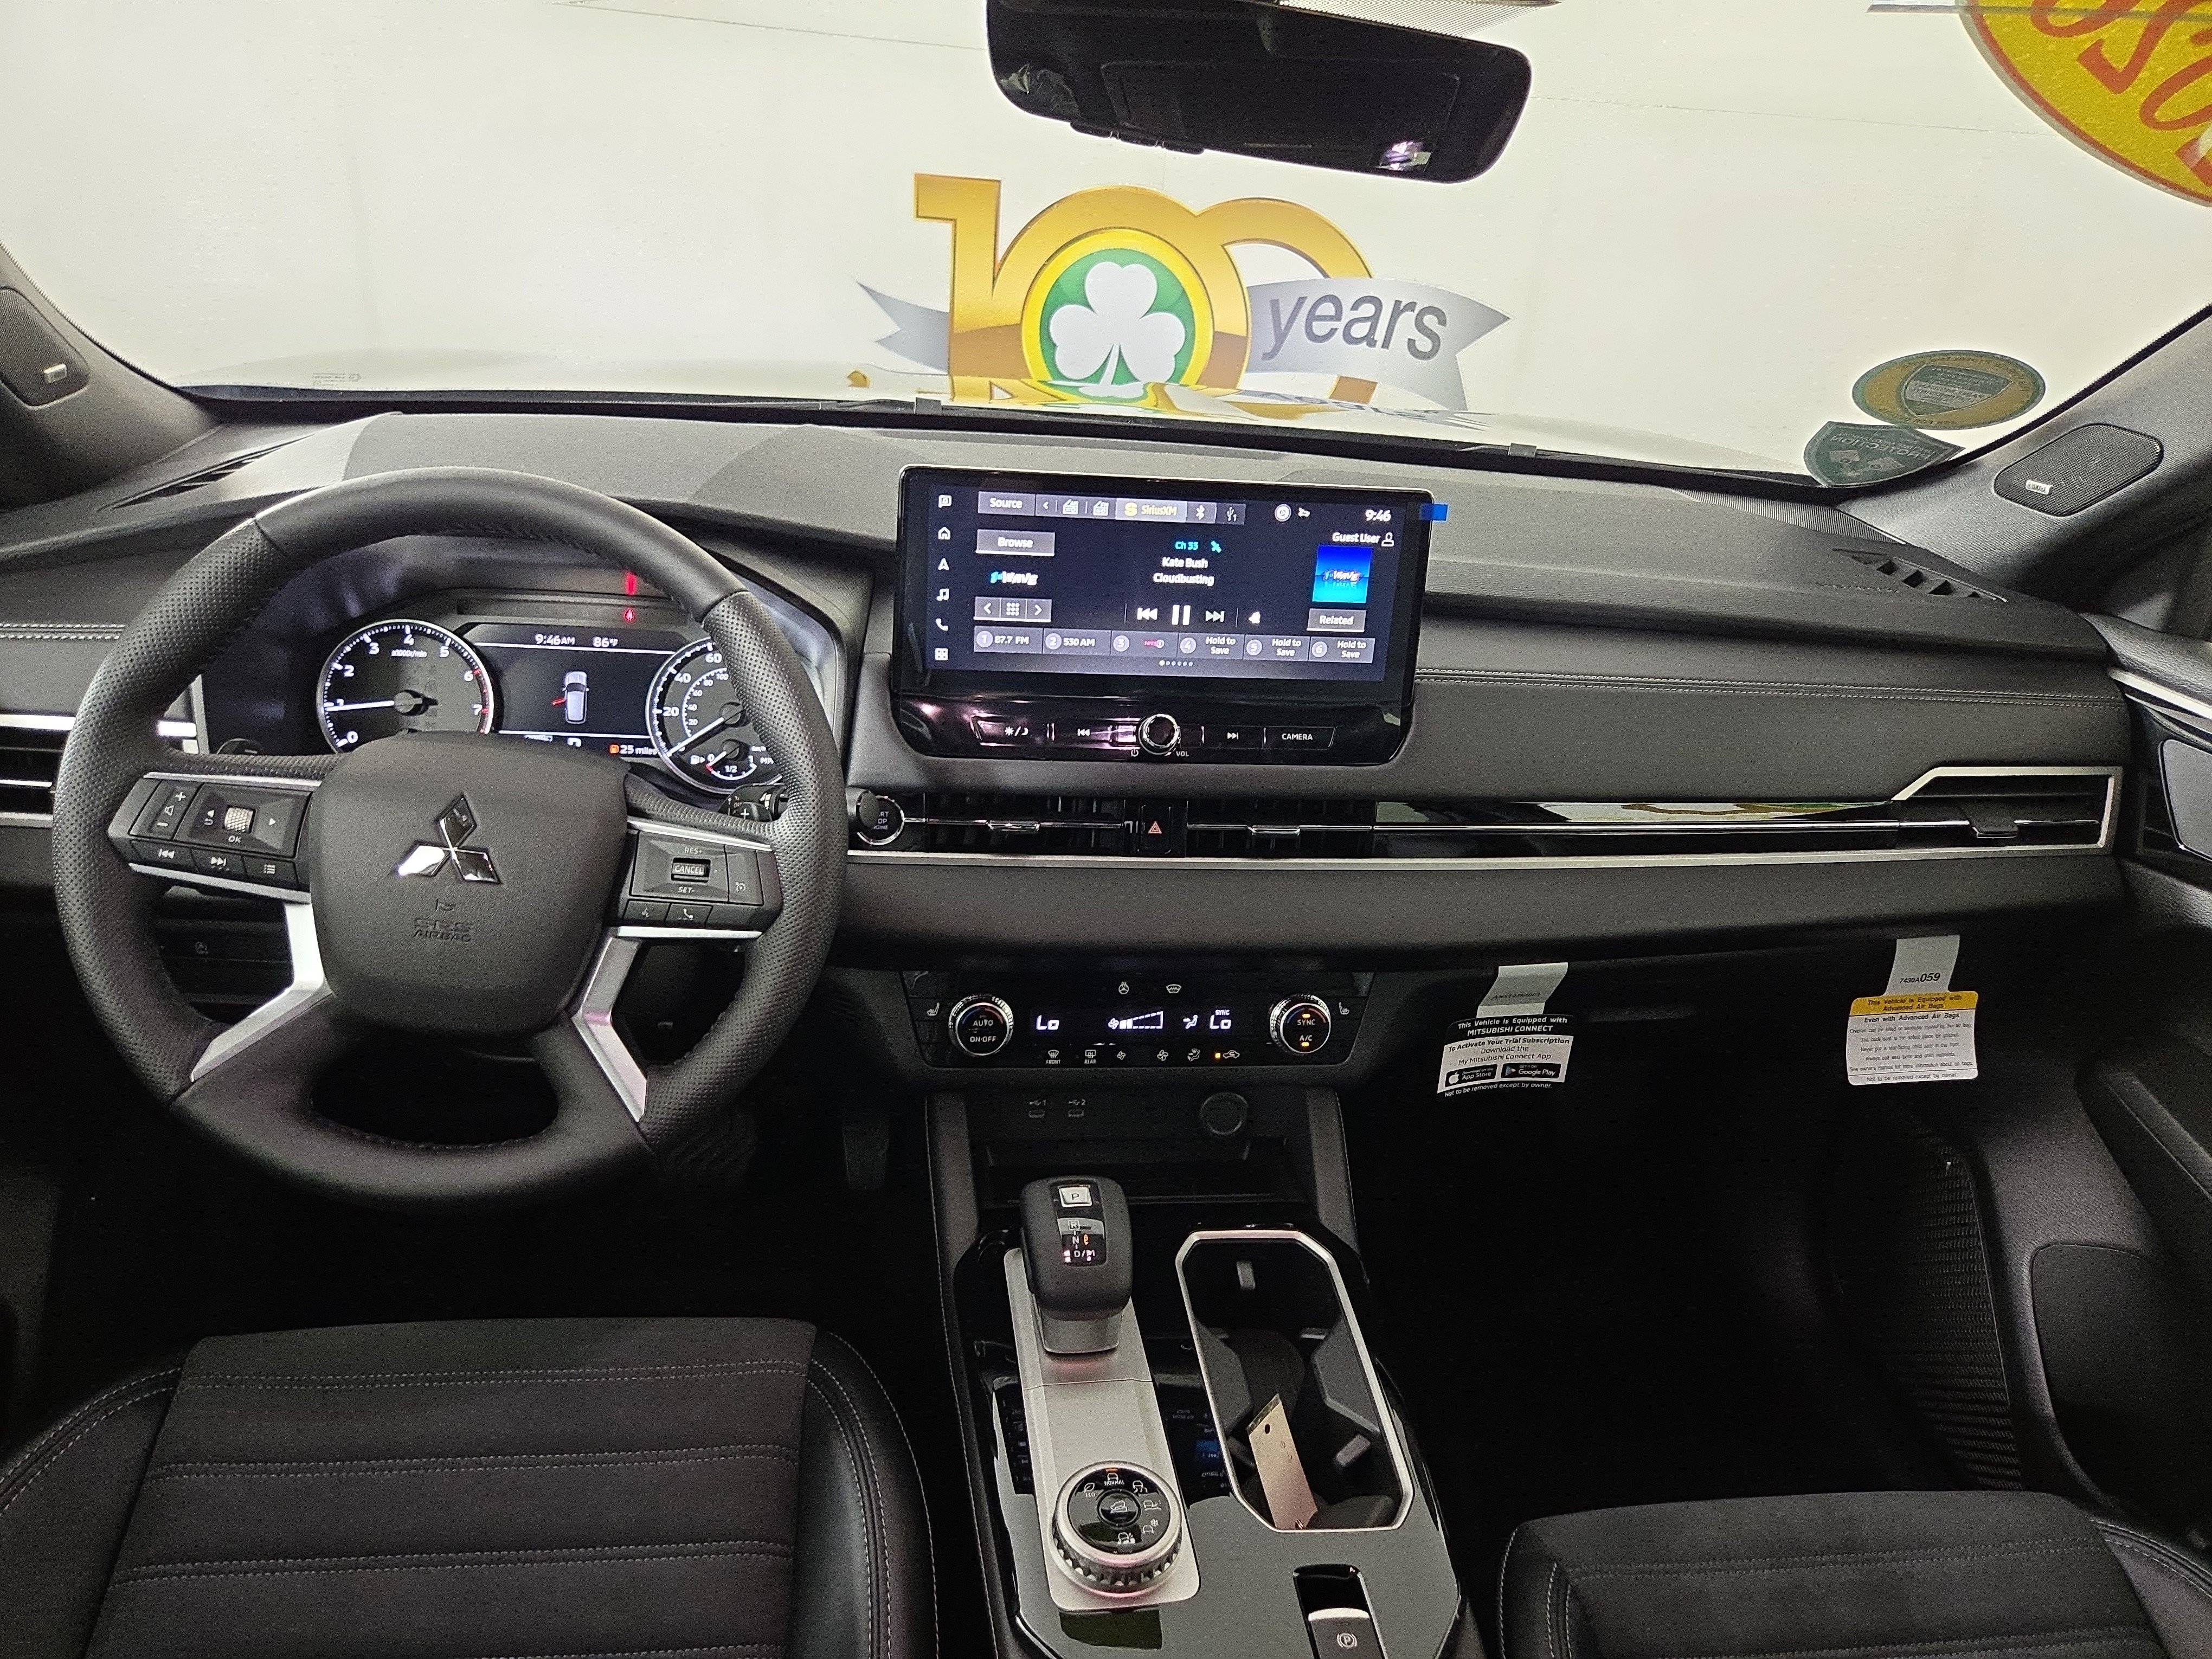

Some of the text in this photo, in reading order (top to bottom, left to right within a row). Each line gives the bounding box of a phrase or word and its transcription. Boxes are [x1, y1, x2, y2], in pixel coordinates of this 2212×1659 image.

[1261, 289, 1450, 362] years
[989, 497, 1024, 509] Source
[1141, 505, 1178, 516] SiriusXM
[1365, 509, 1392, 522] 9:46
[998, 537, 1034, 548] Browse
[1332, 532, 1380, 544] Guest User
[1174, 541, 1186, 550] Ch
[1162, 557, 1208, 569] Kate Bush
[1153, 573, 1214, 587] Cloudbusting
[1319, 615, 1354, 626] Related
[403, 634, 415, 646] 4
[981, 635, 1030, 645] 1 87.7 FM
[1050, 636, 1095, 647] 2 530 AM
[1117, 639, 1124, 647] 3
[1184, 641, 1192, 650] 4
[1206, 636, 1237, 646] Hold to
[1272, 638, 1302, 647] Hold to
[1337, 640, 1367, 650] Hold to
[369, 642, 380, 654] 3
[440, 646, 449, 658] 5
[1210, 646, 1230, 655] Save
[1250, 642, 1258, 652] 5
[1276, 648, 1296, 657] Save
[1315, 645, 1323, 654] 6
[705, 653, 722, 664] 60
[1341, 650, 1360, 659] Save
[344, 665, 355, 677] 2
[464, 670, 473, 681] 6
[674, 672, 691, 684] 40
[473, 704, 483, 716] 7
[663, 706, 679, 717] 20
[347, 731, 358, 743] 0
[619, 745, 657, 756] 25 miles
[724, 765, 737, 773] 1/2
[228, 835, 242, 844] OK
[674, 865, 705, 874] CANCEL
[414, 929, 472, 943] AIRBAG
[1899, 972, 1941, 984] 7430A059
[973, 1019, 994, 1027] AUTO
[1036, 1014, 1060, 1031] Lo
[1209, 1014, 1232, 1030] Lo
[1512, 1017, 1547, 1025] Equipped
[1467, 1026, 1513, 1037] MITSUBISHI
[1299, 1034, 1313, 1042] A/C
[1456, 1041, 1486, 1050] Activate
[1481, 1046, 1515, 1054] Download
[1469, 1053, 1504, 1063] Mitsubishi
[1518, 1069, 1557, 1077] Google Play
[1471, 1083, 1498, 1092] removed
[1072, 1236, 1080, 1244] N
